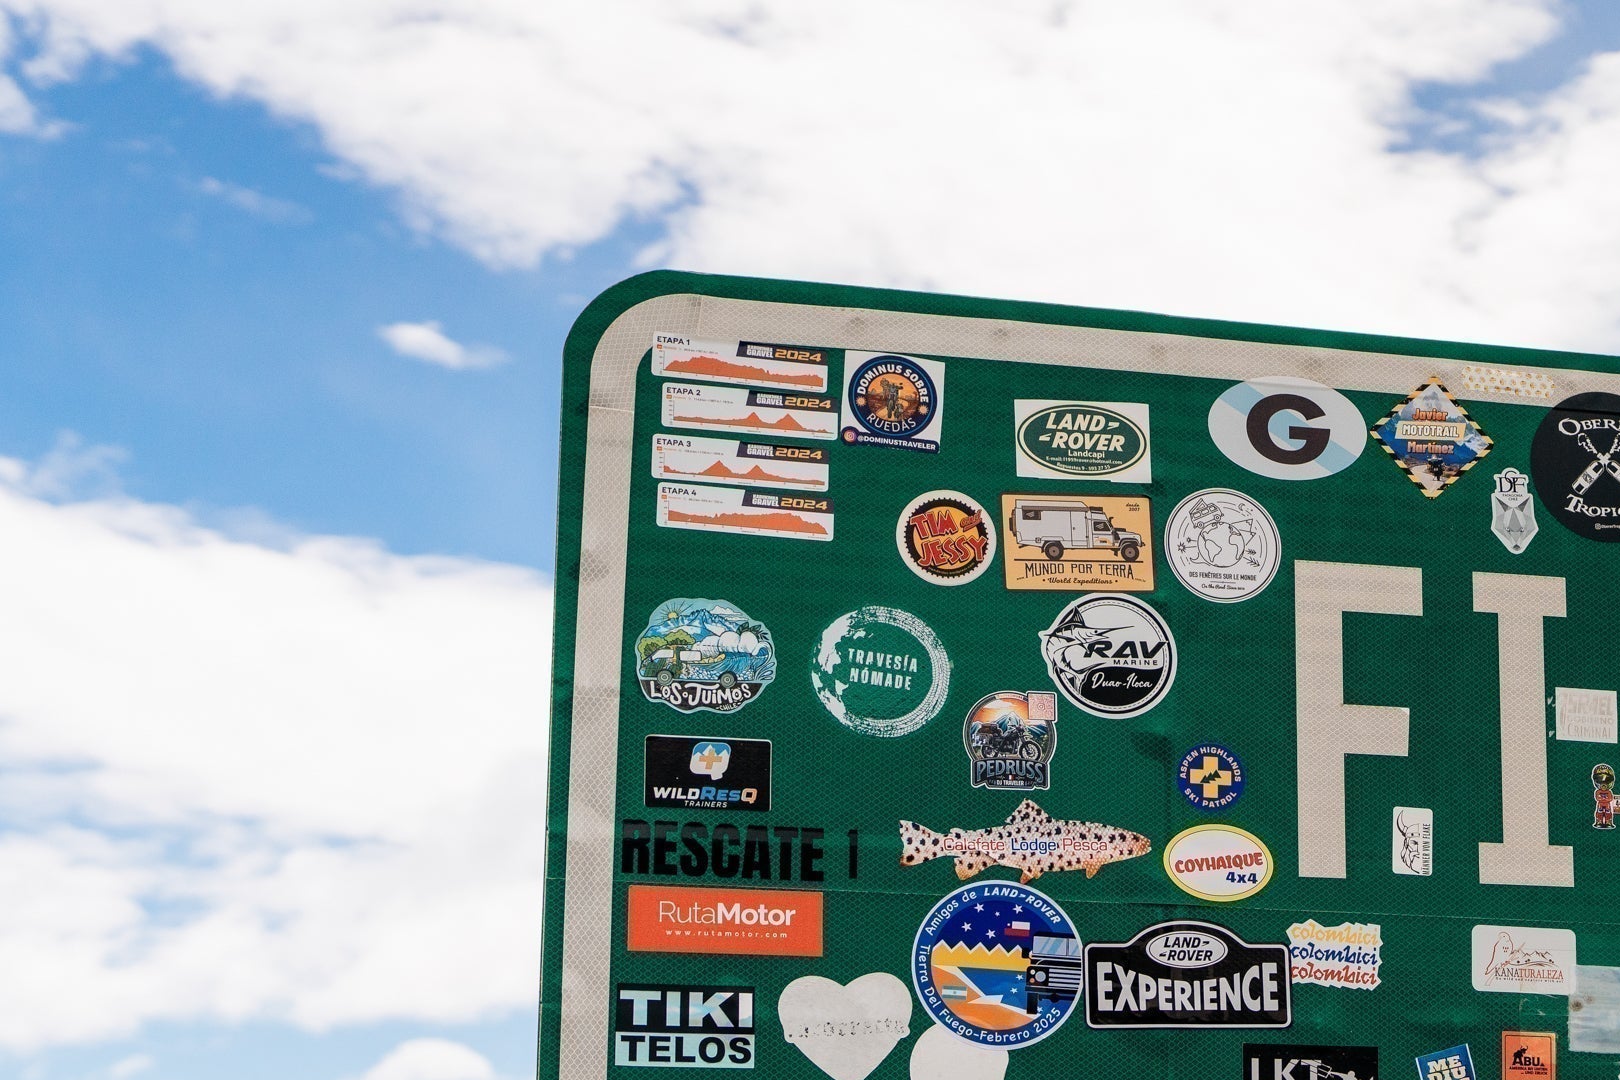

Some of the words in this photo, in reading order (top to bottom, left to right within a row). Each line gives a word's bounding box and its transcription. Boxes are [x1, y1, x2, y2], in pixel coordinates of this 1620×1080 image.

[656, 336, 685, 344] ETAPA
[746, 349, 774, 358] GRAVEL
[775, 349, 822, 362] 2024
[666, 386, 695, 396] ETAPA
[856, 364, 902, 395] DOMINUS
[903, 367, 929, 404] SOBRE
[756, 397, 783, 406] GRAVEL
[785, 396, 832, 409] 2024
[866, 413, 916, 432] RUEDAS
[1047, 412, 1106, 431] LAND
[1402, 424, 1459, 439] MOTOTRAIL
[656, 438, 685, 447] ETAPA
[1051, 433, 1126, 452] ROVER
[746, 448, 774, 457] GRAVEL
[775, 447, 823, 460] 2024
[661, 487, 690, 496] ETAPA
[752, 497, 780, 507] GRAVEL
[780, 497, 827, 510] 2024
[919, 536, 988, 568] JESSY
[1025, 563, 1065, 579] MUNDO
[1070, 562, 1093, 575] POR
[1099, 563, 1134, 579] TERRA
[976, 760, 1043, 782] PEDRUSS
[1180, 751, 1199, 779] ASPEN
[1200, 746, 1241, 782] HIGHLANDS
[684, 800, 728, 808] TRAINERS
[1184, 788, 1200, 803] SKI
[1201, 790, 1237, 808] PATROL
[942, 837, 1005, 852] Calafate
[1011, 837, 1057, 854] Lodge
[1062, 837, 1108, 852] Pesca
[658, 900, 796, 926] RutaMotor
[925, 900, 958, 936] Amigos
[961, 890, 978, 904] de
[984, 886, 1016, 898] LAND
[1024, 894, 1062, 925] ROVER
[665, 929, 788, 938] www.rutamotor.com
[1163, 936, 1200, 948] LAND
[920, 944, 931, 984] Tierra
[1166, 949, 1213, 962] ROVER
[1098, 961, 1279, 1012] EXPERIENCE
[925, 987, 940, 1008] Del
[620, 990, 753, 1028] TIKI
[1033, 1008, 1062, 1034] 2025
[621, 1035, 751, 1063] TELOS
